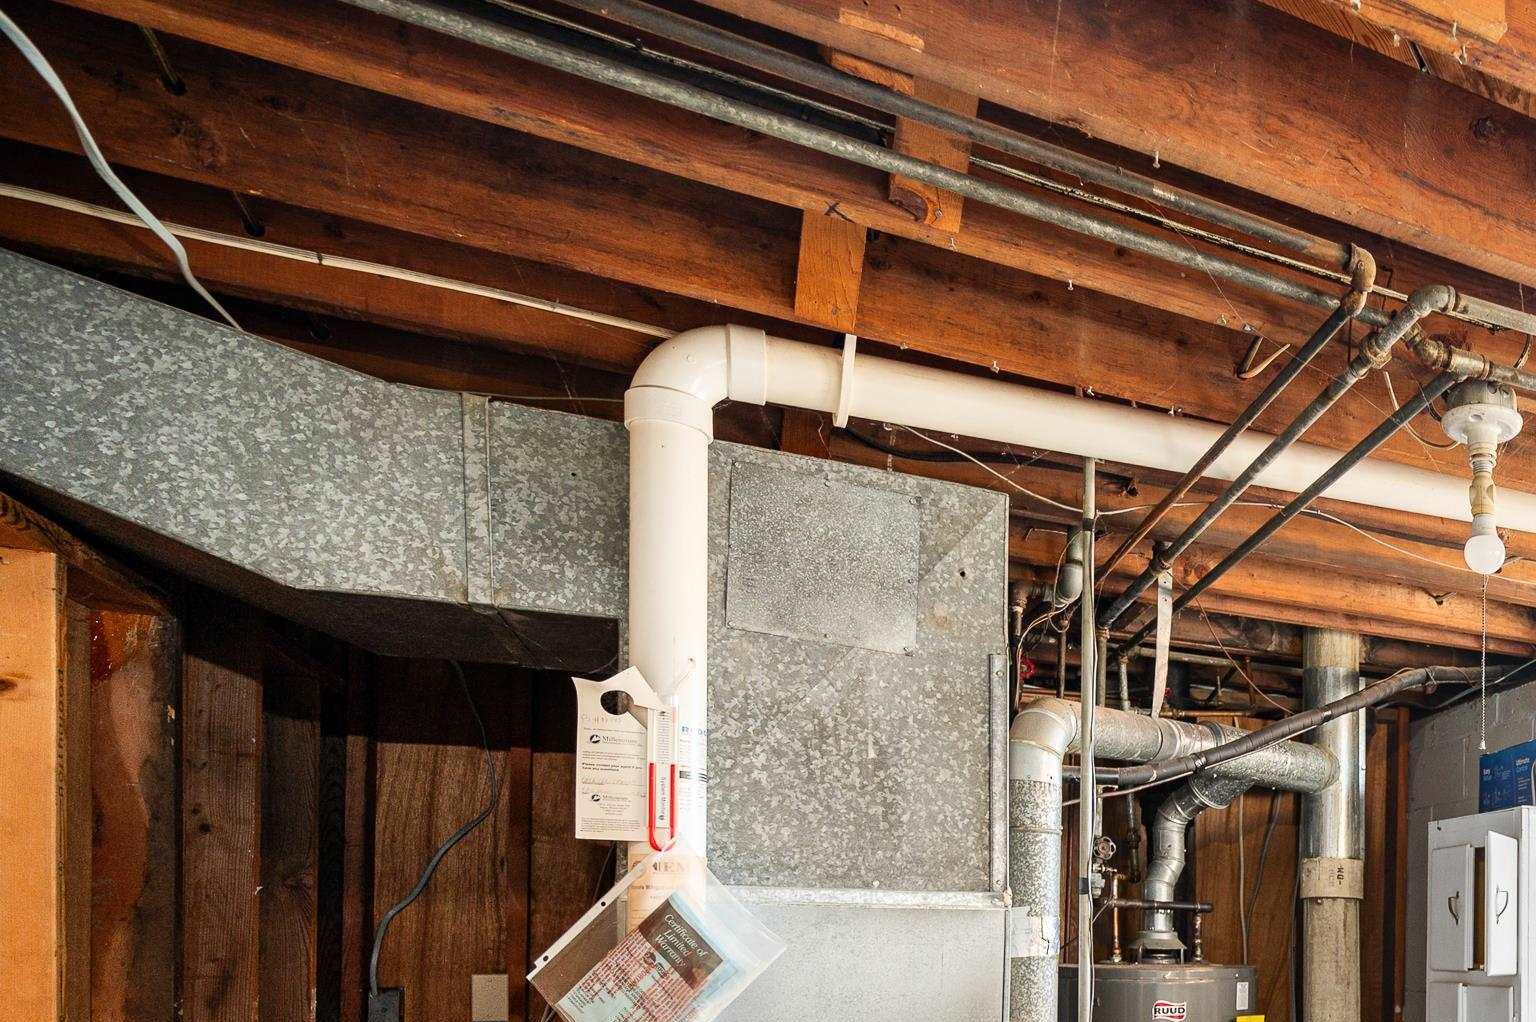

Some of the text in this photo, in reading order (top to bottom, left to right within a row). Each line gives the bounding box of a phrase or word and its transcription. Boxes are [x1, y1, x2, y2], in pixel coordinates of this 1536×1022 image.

[664, 913, 710, 959] Certificate of
[664, 930, 693, 957] Limited
[1154, 1006, 1186, 1014] RUUD
